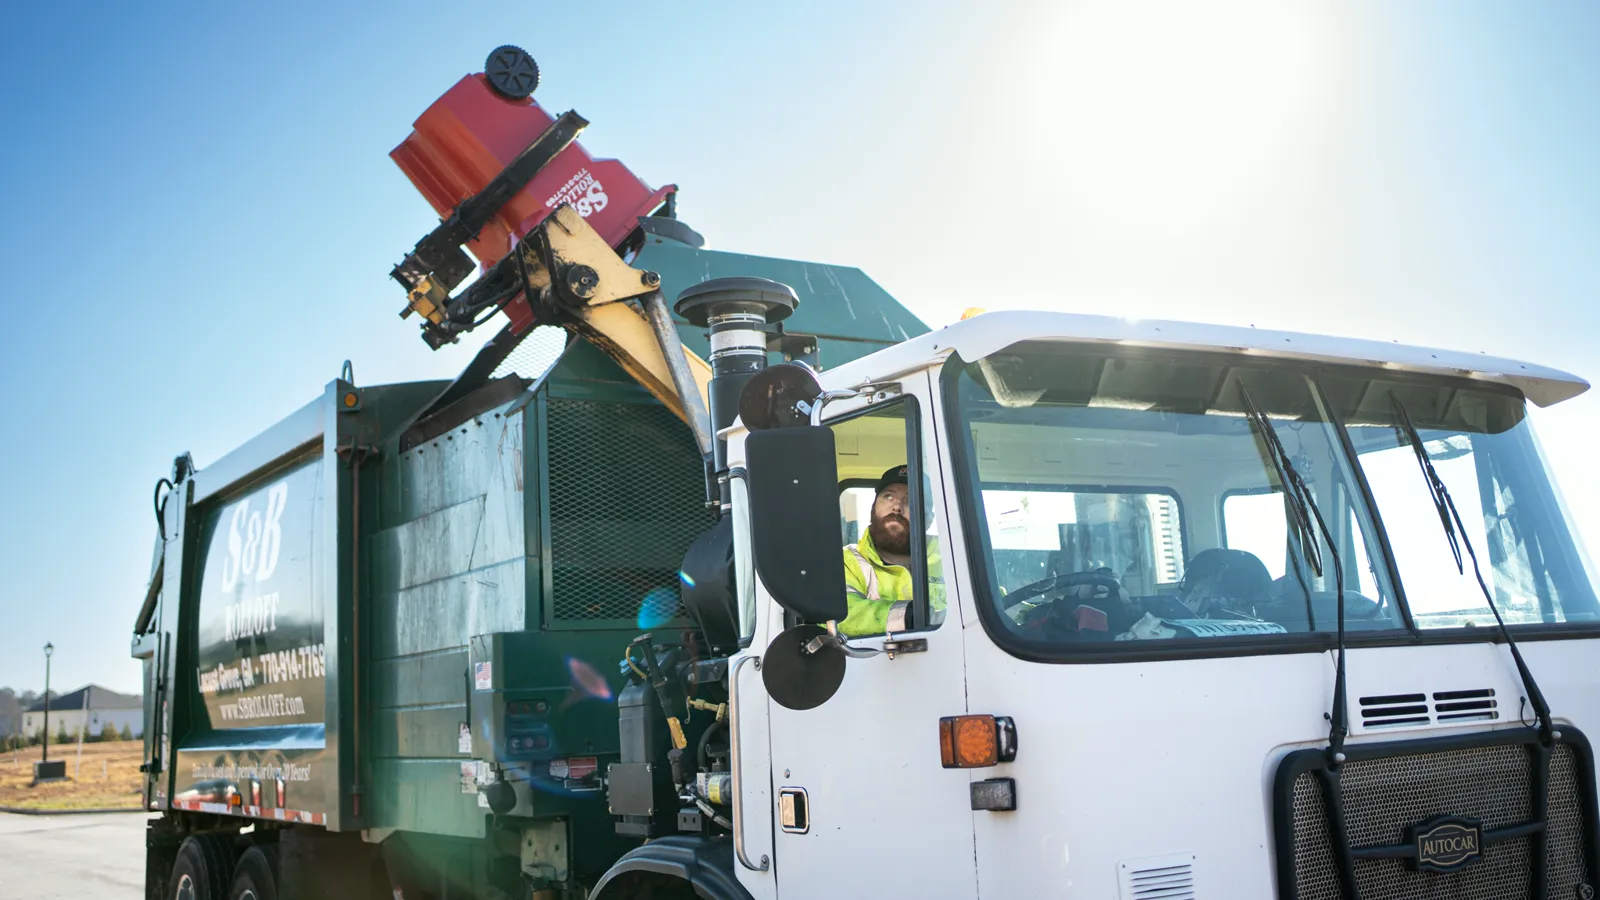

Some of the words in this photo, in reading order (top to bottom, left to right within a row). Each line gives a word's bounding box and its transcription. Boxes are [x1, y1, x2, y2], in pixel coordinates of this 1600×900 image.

[222, 481, 288, 593] S&B
[224, 592, 279, 641] ROLLOFF
[241, 657, 255, 687] GA
[260, 643, 325, 684] 770-914-7769
[220, 693, 305, 720] www.SBROLLOFF.com
[290, 763, 311, 781] Years!
[1423, 835, 1475, 856] AUTOCAR
